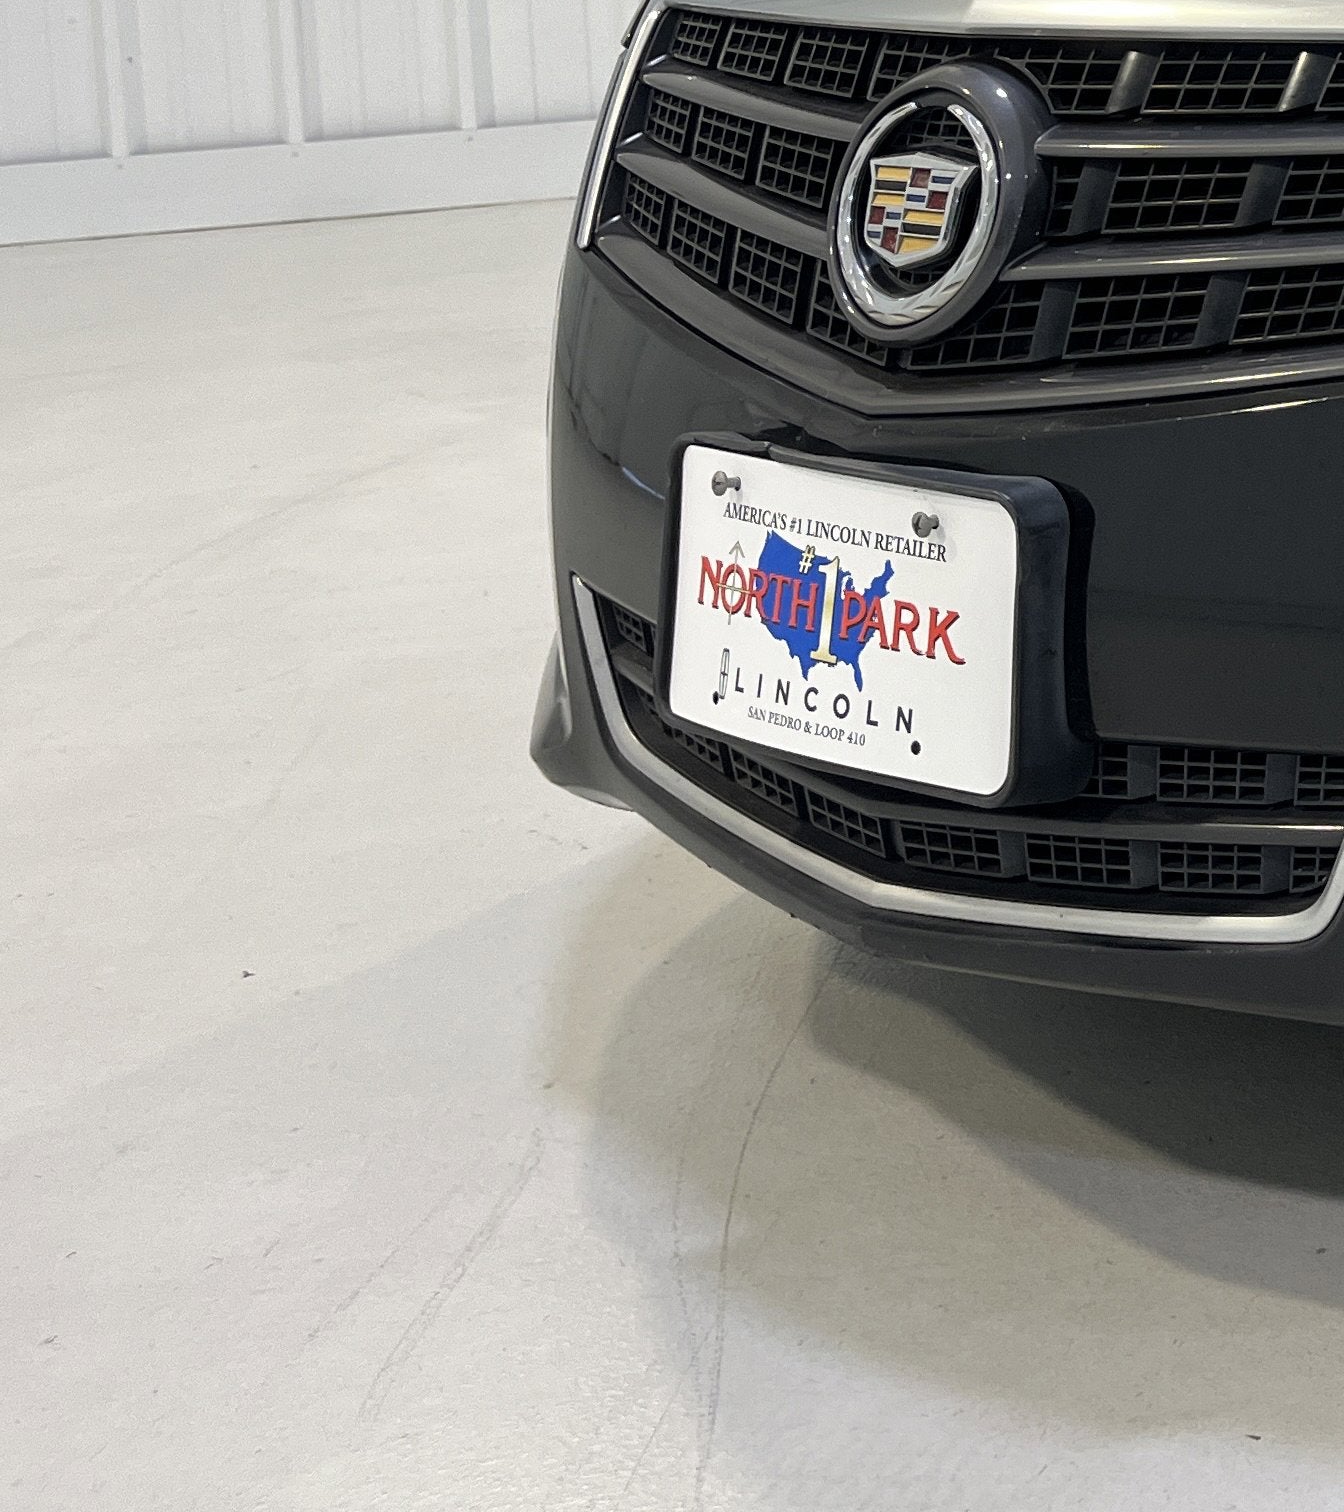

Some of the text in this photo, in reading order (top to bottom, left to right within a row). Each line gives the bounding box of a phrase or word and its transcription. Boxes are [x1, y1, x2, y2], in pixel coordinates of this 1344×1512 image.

[723, 501, 947, 563] AMERICA'S #1 LINCOLN RETAILER
[698, 555, 967, 665] NORTH PARK
[734, 667, 914, 734] LINCOLN
[747, 705, 867, 747] SAN PEDRO & LOOP 410
